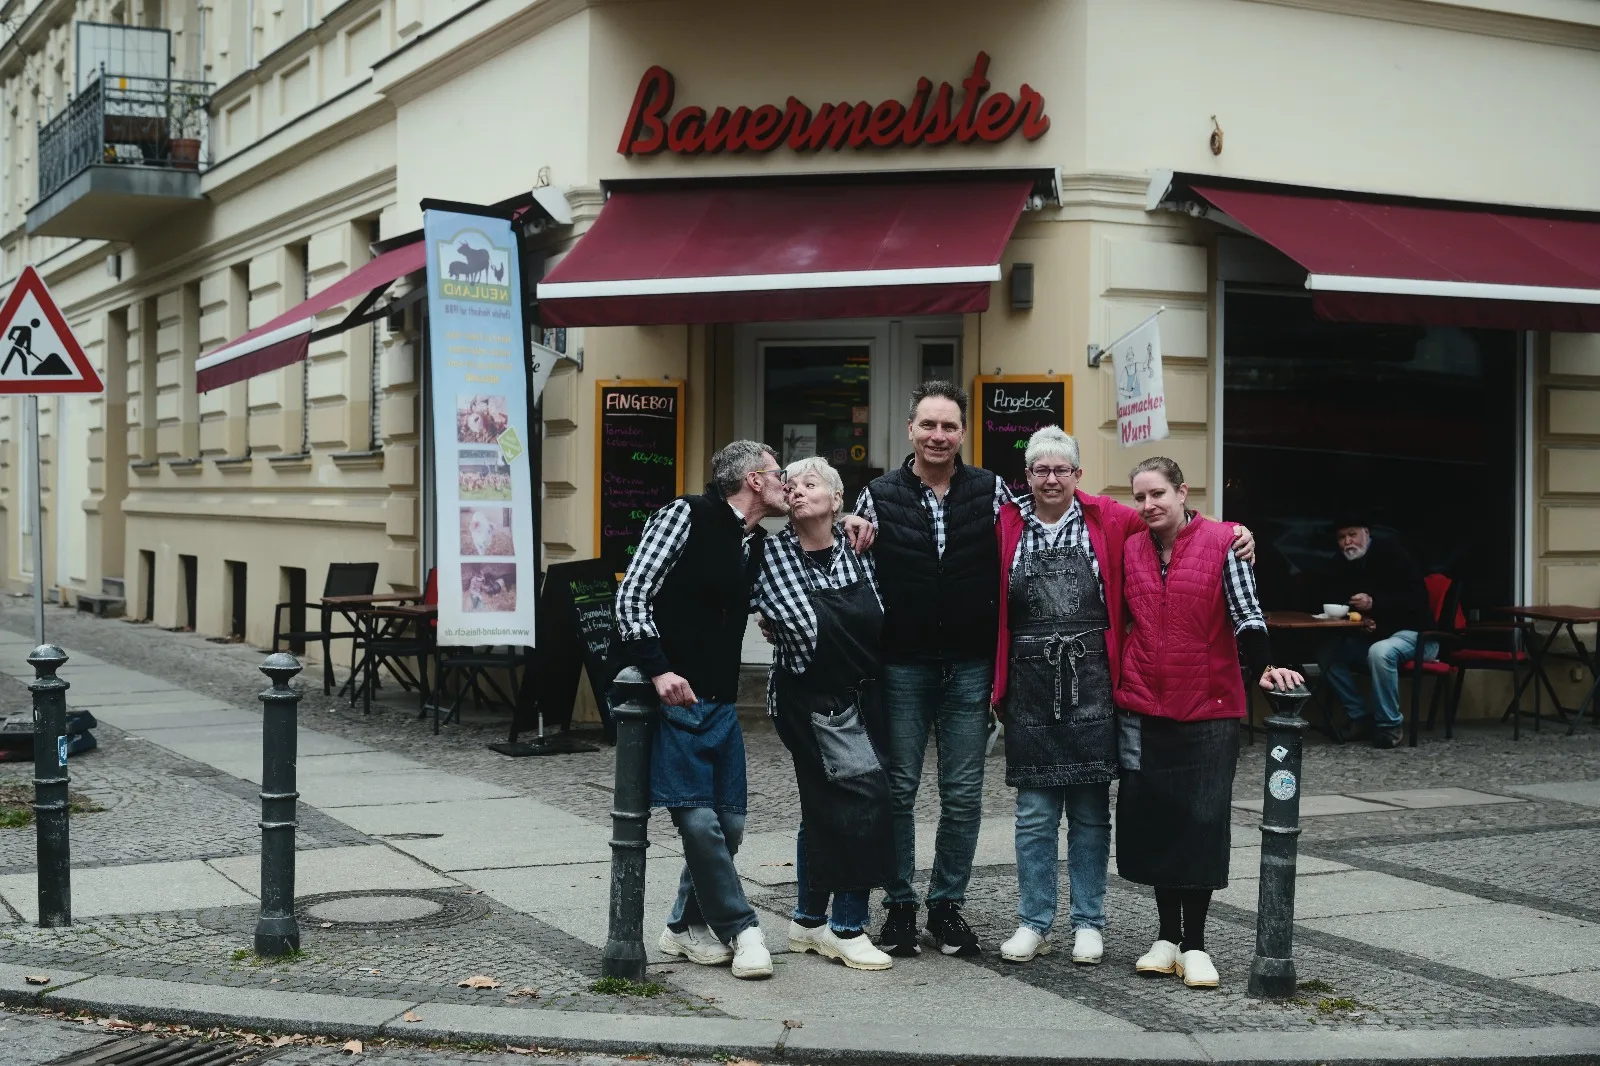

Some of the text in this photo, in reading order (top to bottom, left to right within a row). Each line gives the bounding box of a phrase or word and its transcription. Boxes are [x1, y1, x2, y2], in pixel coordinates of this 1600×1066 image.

[617, 50, 1050, 156] Bauermeister
[606, 393, 674, 413] ANGEBOT
[994, 388, 1053, 412] Angebot
[1121, 416, 1152, 444] Wurst
